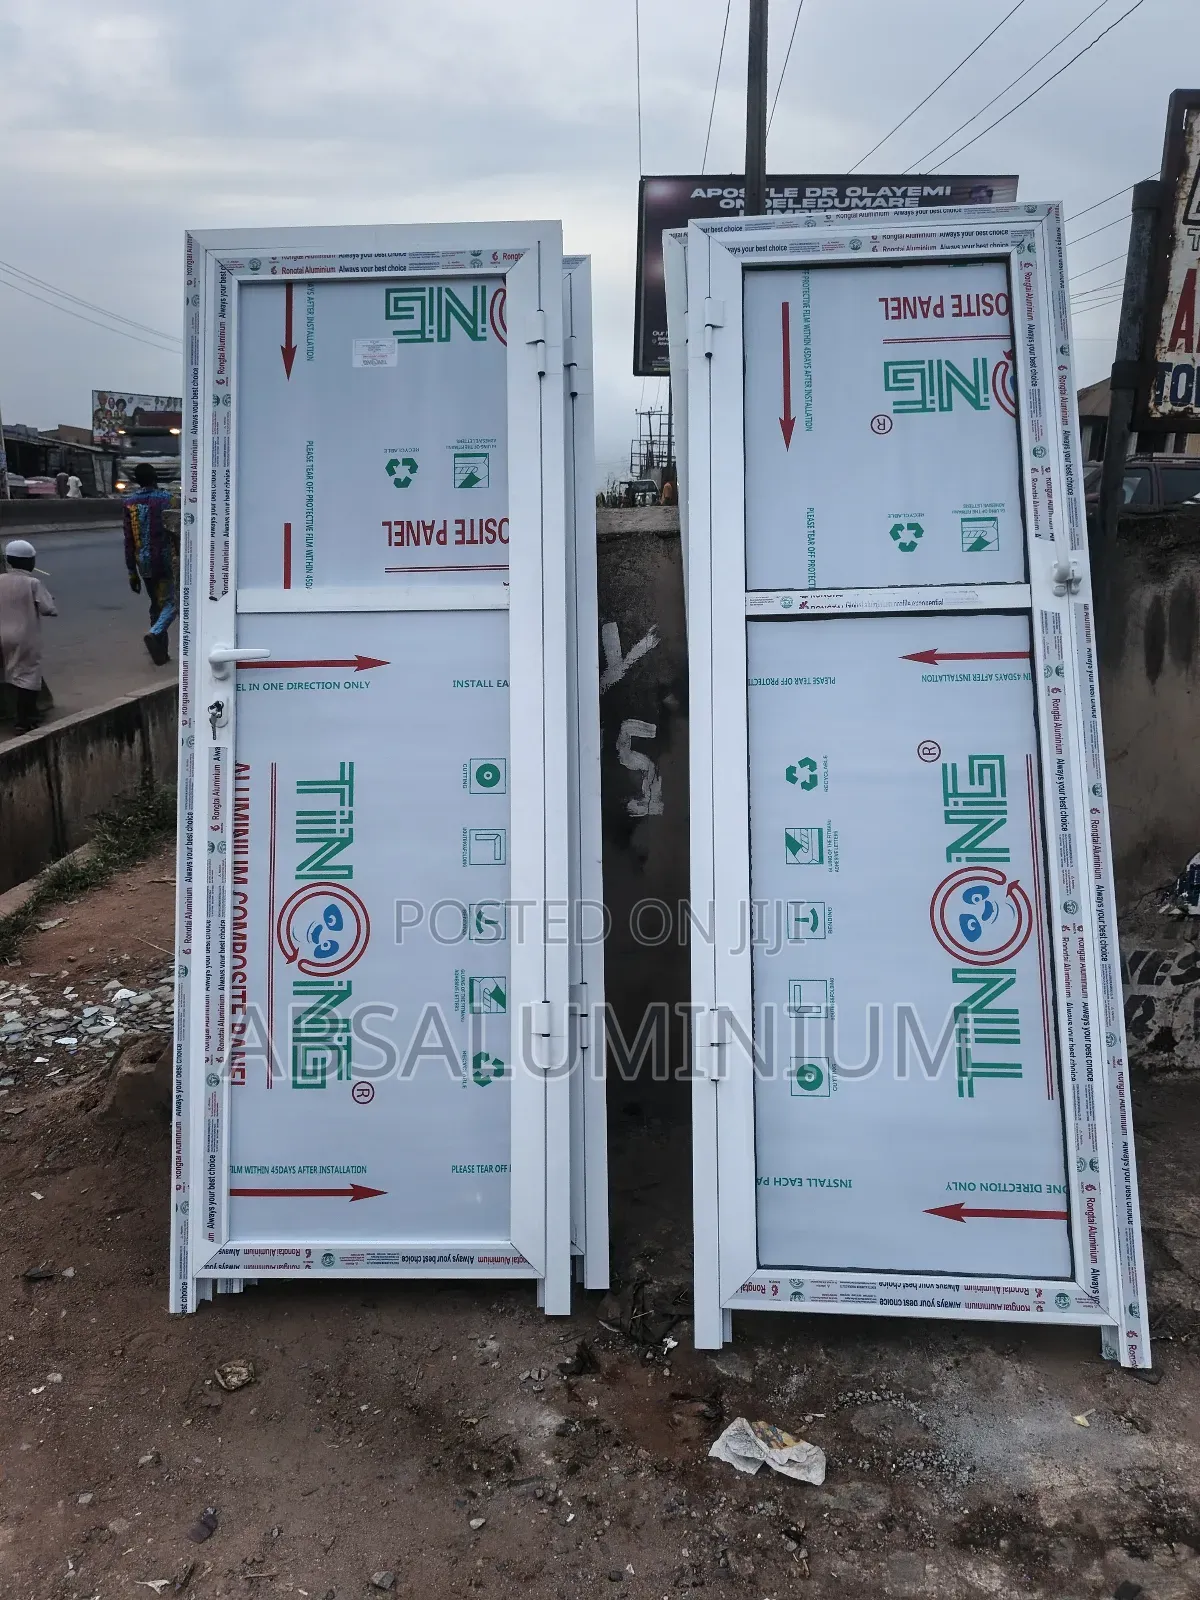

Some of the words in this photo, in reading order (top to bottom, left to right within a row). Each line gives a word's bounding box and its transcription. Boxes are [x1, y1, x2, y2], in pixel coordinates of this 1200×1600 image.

[805, 188, 837, 198] DR
[846, 186, 951, 198] OLAYEMI
[1023, 272, 1033, 292] Rongtai
[802, 277, 810, 309] PROTECTIVE
[219, 298, 228, 318] Always
[879, 295, 944, 320] PANEL
[951, 293, 1009, 317] OSITE
[1026, 293, 1034, 320] Aluminium
[803, 310, 811, 324] FILM
[803, 324, 811, 346] WITHIN
[1026, 324, 1035, 342] Always
[1027, 344, 1035, 356] your
[218, 353, 226, 374] Rongtai
[804, 370, 812, 389] AFTER
[1030, 369, 1039, 386] choice
[1058, 375, 1067, 395] Rongtai
[805, 390, 813, 432] INSTALLATION
[1060, 396, 1069, 425] Aluminium
[1062, 430, 1071, 449] Always
[1063, 450, 1071, 462] your
[382, 520, 447, 546] PANEL
[263, 682, 284, 690] ONE
[287, 681, 340, 690] DIRECTION
[795, 677, 811, 685] TEAR
[813, 676, 835, 684] PLEASE
[921, 674, 972, 682] INSTALLATION
[972, 673, 993, 682] AFTER
[995, 673, 1021, 681] 45DAYS
[1051, 699, 1061, 721] Rongtai
[1054, 723, 1064, 754] Aluminium
[1055, 758, 1065, 780] Always
[212, 765, 220, 796] Aluminium
[1056, 781, 1065, 795] your
[212, 799, 221, 820] Rongtai
[1060, 796, 1069, 810] best
[185, 812, 193, 831] choice
[1060, 811, 1069, 831] choice
[185, 833, 193, 845] best
[1091, 820, 1100, 844] Rongtai
[1093, 846, 1103, 879] Aluminium
[184, 888, 192, 919] Aluminium
[1095, 885, 1105, 907] Always
[1096, 909, 1106, 924] your
[1098, 925, 1107, 939] best
[1100, 940, 1109, 962] choice
[207, 1155, 216, 1175] choice
[244, 1166, 270, 1174] WITHIN
[271, 1166, 296, 1174] 45DAYS
[298, 1166, 318, 1174] AFTER
[320, 1165, 367, 1174] INSTALLATION
[452, 1165, 475, 1173] PLEASE
[477, 1165, 494, 1173] TEAR
[207, 1176, 215, 1190] best
[774, 1177, 802, 1187] EACH
[807, 1178, 852, 1188] INSTALL
[945, 1182, 977, 1192] ONLY
[980, 1183, 1042, 1193] DIRECTION
[207, 1207, 216, 1229] Always
[1085, 1198, 1097, 1224] Rongtai
[1088, 1226, 1099, 1263] Aluminium
[402, 1256, 421, 1264] choice
[422, 1256, 435, 1264] best
[436, 1254, 451, 1262] your
[452, 1254, 474, 1264] Always
[478, 1256, 510, 1264] Aluminium
[1090, 1268, 1100, 1294] Always
